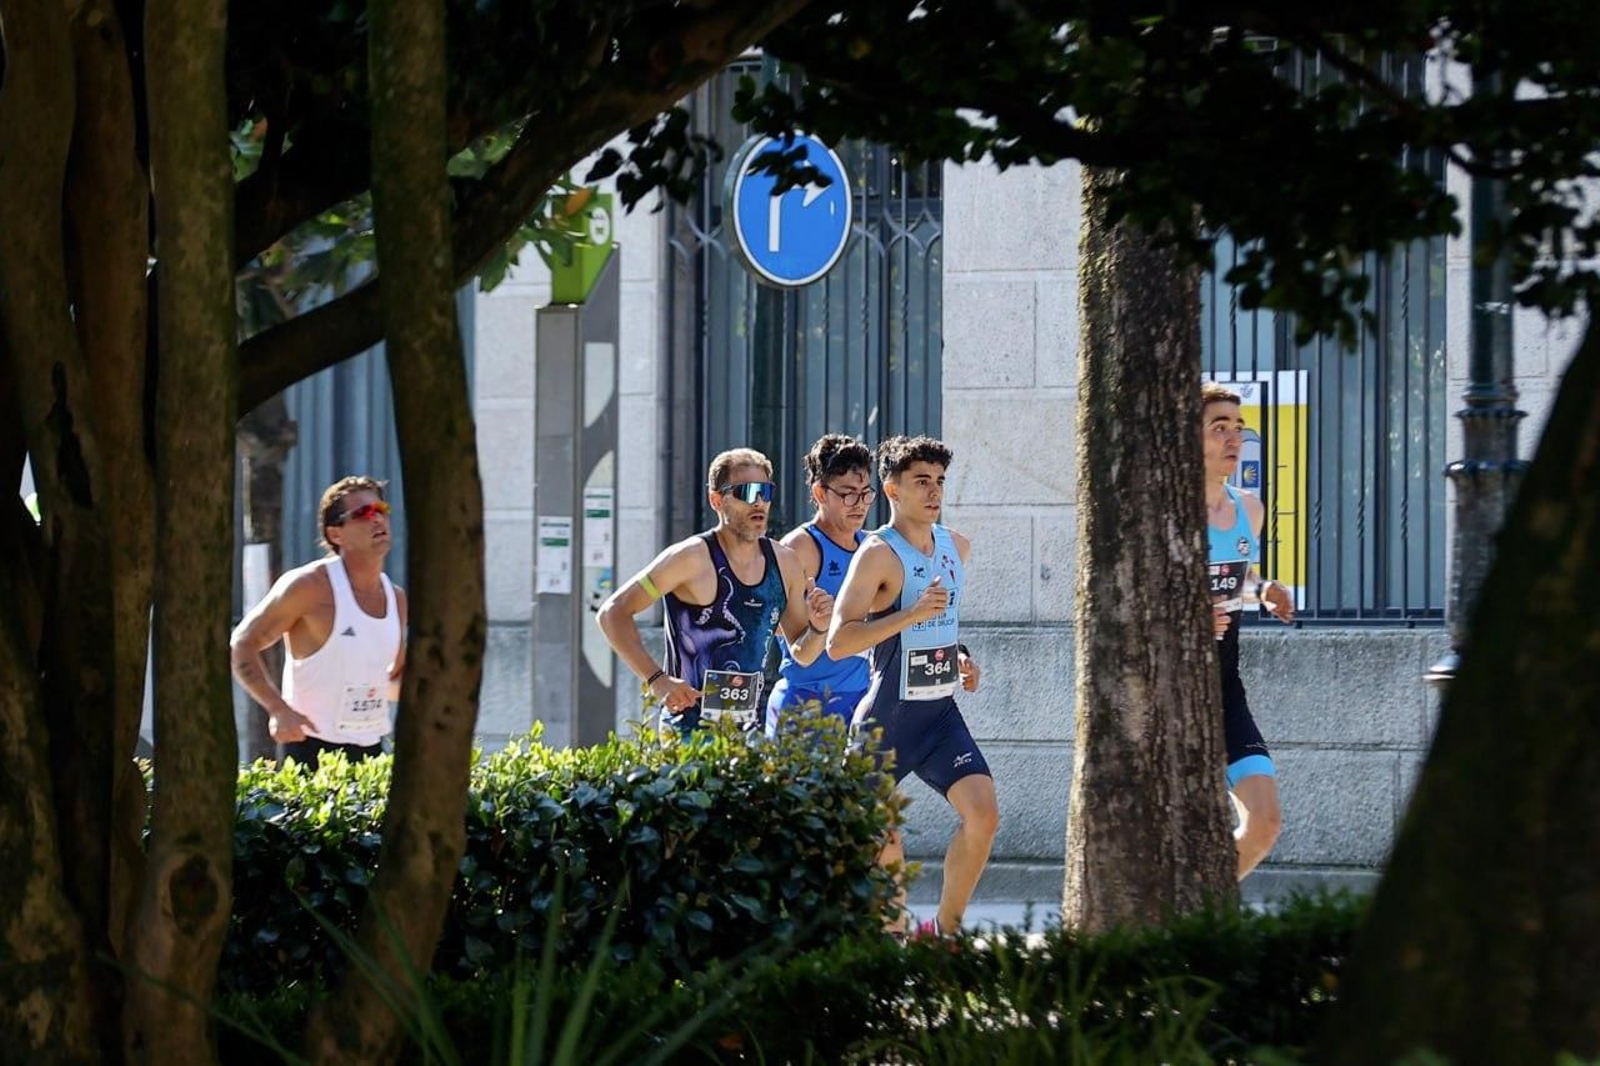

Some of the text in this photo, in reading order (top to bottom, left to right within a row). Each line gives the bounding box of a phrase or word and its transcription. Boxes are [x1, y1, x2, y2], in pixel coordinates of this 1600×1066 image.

[1210, 576, 1238, 591] 149
[924, 660, 952, 676] 364
[719, 687, 750, 701] 363
